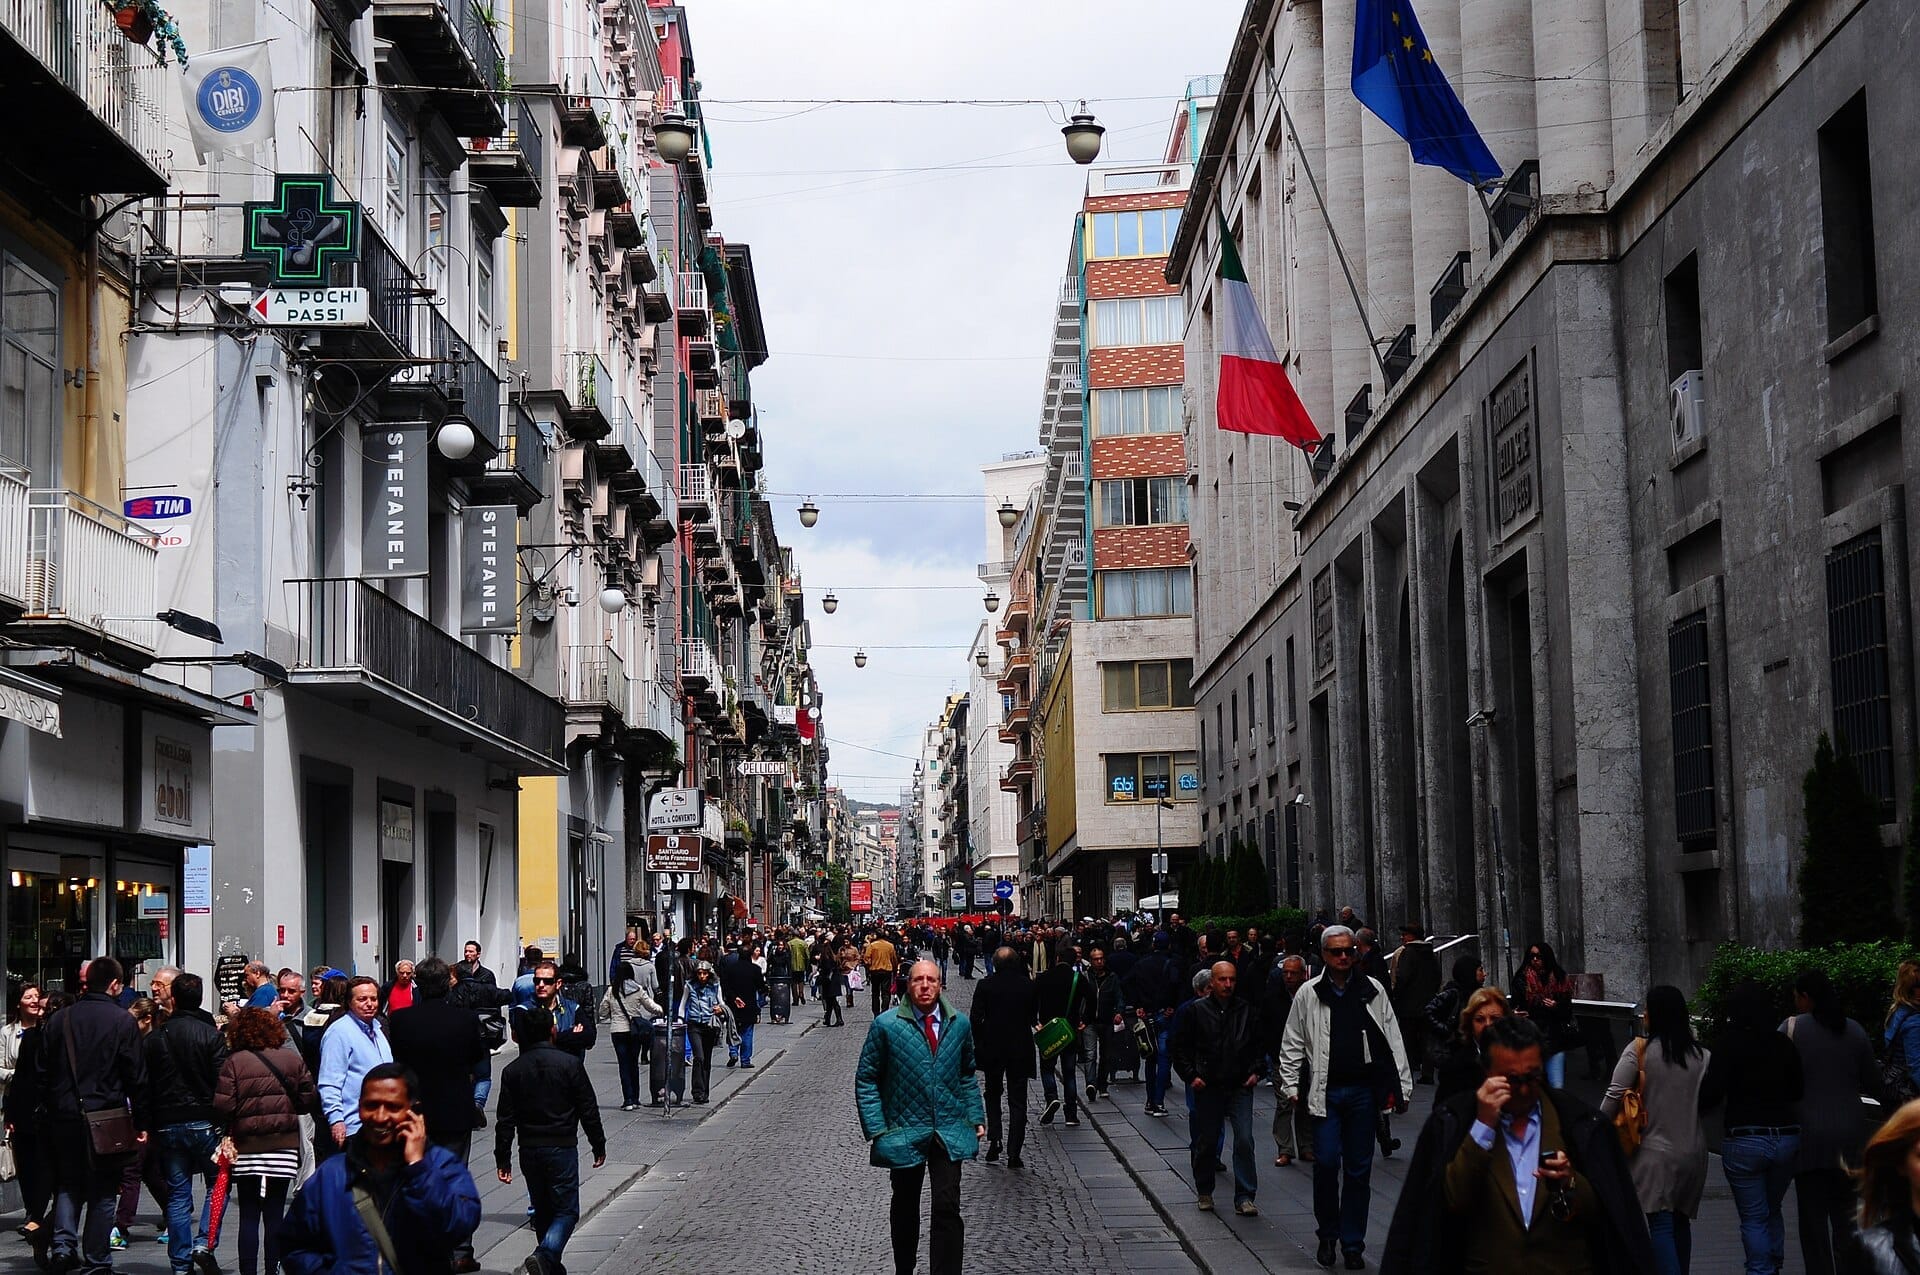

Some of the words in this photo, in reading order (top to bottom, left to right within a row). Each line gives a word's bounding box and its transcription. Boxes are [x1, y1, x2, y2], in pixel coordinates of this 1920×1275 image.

[212, 87, 244, 112] DIBI
[217, 106, 246, 116] CENTER
[275, 292, 287, 304] A
[299, 290, 358, 304] POCHI
[287, 308, 344, 322] PASSI
[155, 499, 185, 514] TIM
[387, 432, 404, 570] STEFANEL
[482, 511, 497, 627] STEFANEL
[743, 762, 784, 774] PELLICCE
[1112, 776, 1134, 791] fabi
[1179, 774, 1198, 789] fab
